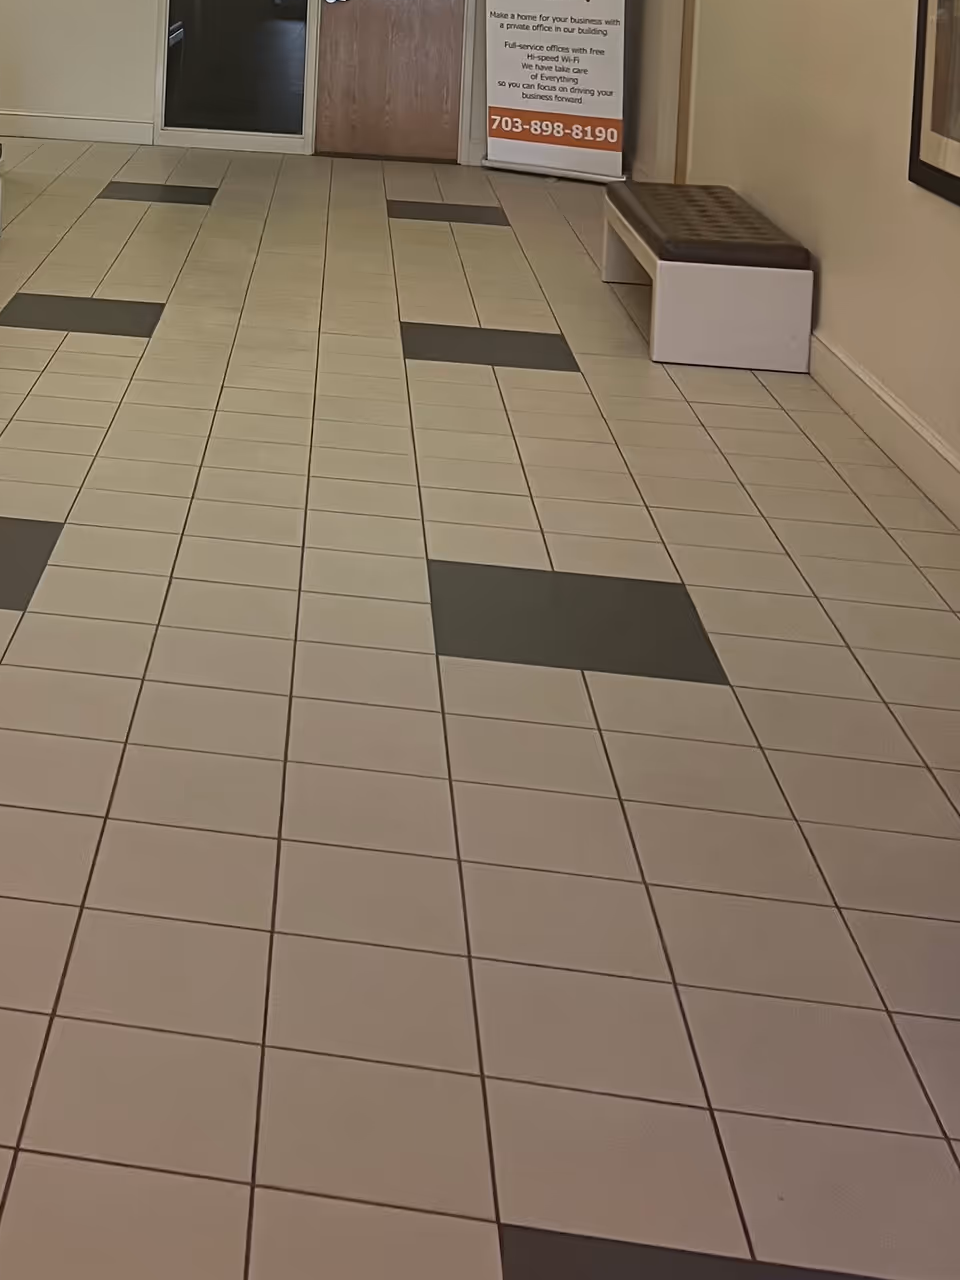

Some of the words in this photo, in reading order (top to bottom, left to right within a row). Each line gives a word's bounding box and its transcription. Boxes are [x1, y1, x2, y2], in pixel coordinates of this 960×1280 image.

[490, 11, 509, 20] Make
[517, 12, 537, 22] home
[539, 14, 550, 22] for
[551, 16, 568, 24] your
[570, 16, 603, 26] business
[604, 18, 621, 26] with
[506, 22, 531, 32] private
[532, 24, 553, 32] office
[555, 25, 562, 33] in
[563, 26, 576, 34] our
[578, 26, 608, 37] building
[504, 40, 544, 52] Full-service
[546, 44, 570, 54] offices
[571, 46, 588, 55] with
[589, 47, 605, 56] free
[527, 53, 559, 63] Hi-speed
[561, 55, 580, 64] Wi-Fi
[535, 63, 553, 72] have
[555, 65, 570, 74] take
[572, 67, 588, 75] care
[530, 73, 539, 81] of
[540, 74, 579, 85] Everything
[508, 82, 520, 90] you
[537, 82, 557, 92] focus
[570, 86, 595, 97] driving
[597, 90, 614, 98] your
[521, 91, 553, 102] business
[554, 94, 583, 104] forward
[490, 115, 618, 143] 703-898-8190
